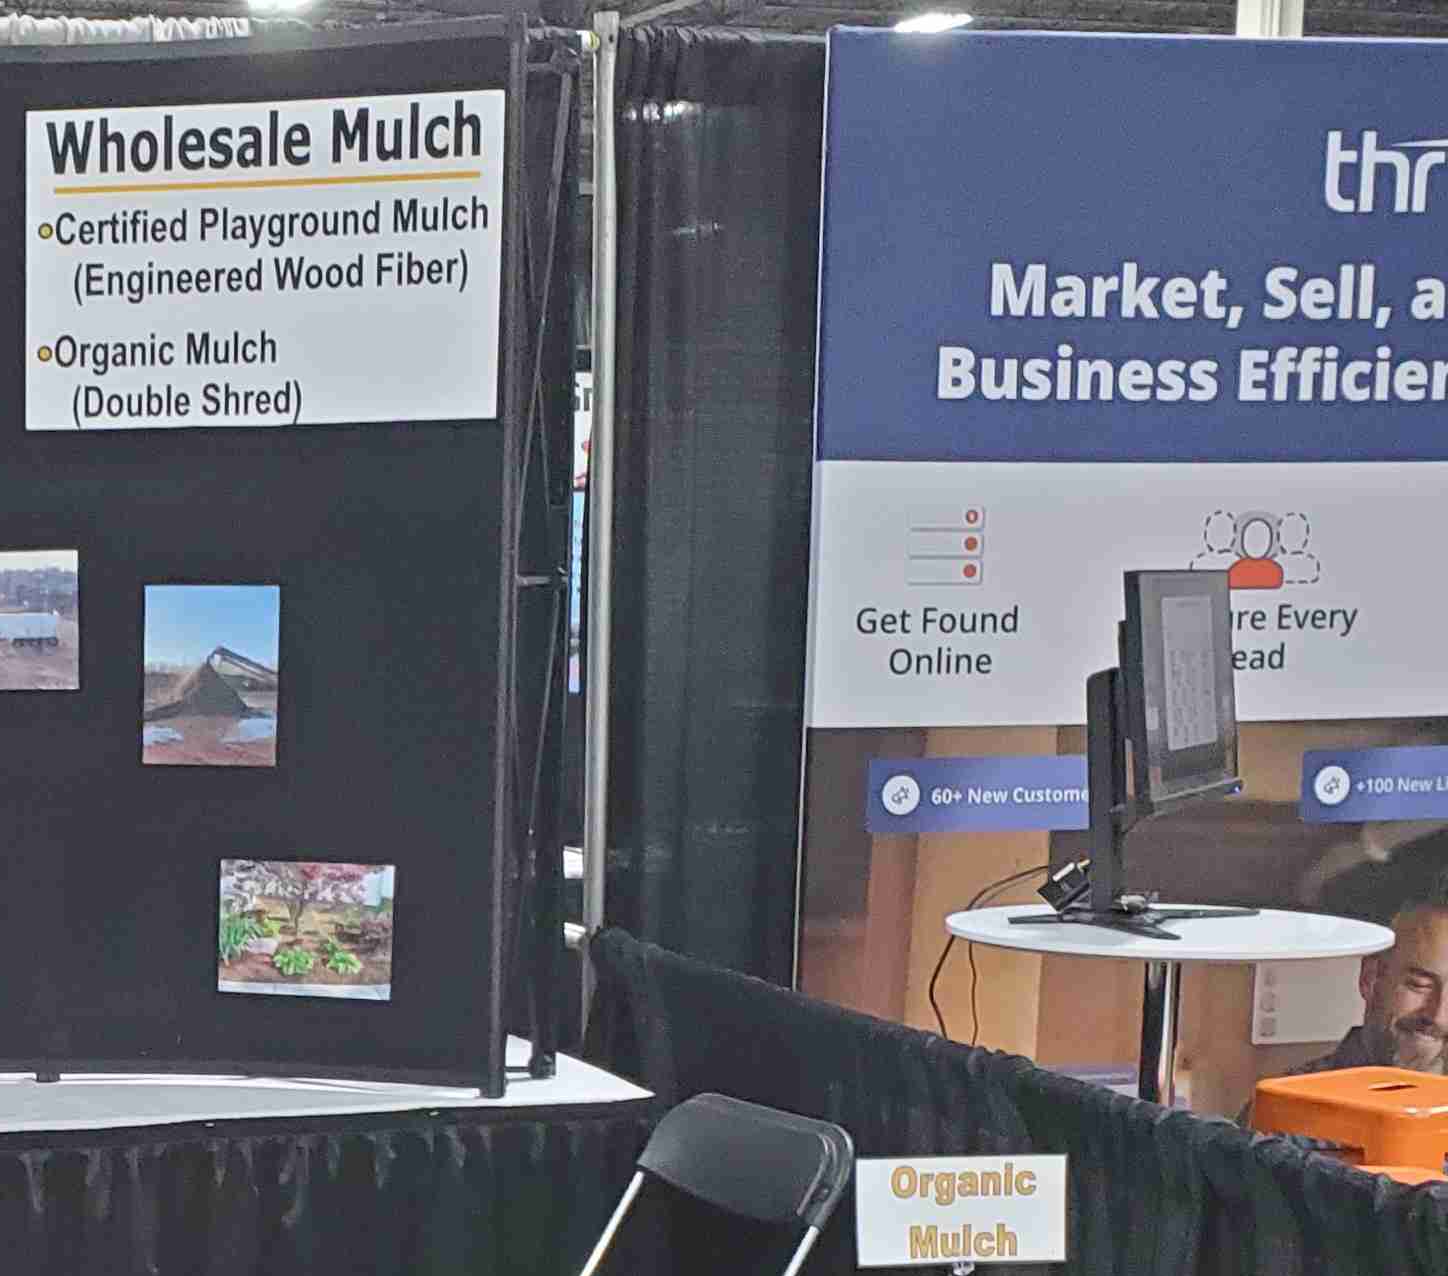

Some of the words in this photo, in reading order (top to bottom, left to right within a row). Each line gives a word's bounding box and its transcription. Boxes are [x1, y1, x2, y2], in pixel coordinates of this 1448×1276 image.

[46, 115, 311, 175] Wholesale
[331, 100, 482, 164] Mulch
[1325, 131, 1448, 212] thr
[56, 208, 187, 245] Certified
[200, 200, 380, 248] Playground
[393, 196, 488, 233] Mulch
[74, 258, 262, 306] (Engineered
[274, 254, 363, 290] Wood
[377, 249, 467, 292] Fiber)
[991, 262, 1243, 328] Market,
[1263, 264, 1391, 328] Sell,
[55, 333, 174, 376] Organic
[187, 330, 276, 365] Mulch
[938, 344, 1218, 401] Business
[72, 384, 191, 430] (Double
[202, 380, 303, 424] Shred)
[857, 608, 911, 634] Get
[923, 605, 1018, 634] Found
[1229, 609, 1267, 631] re
[1278, 604, 1358, 637] Every
[889, 647, 992, 675] Online
[1232, 642, 1285, 670] ead
[932, 788, 962, 805] 60+
[968, 787, 1008, 804] New
[1397, 776, 1433, 792] New
[1436, 776, 1448, 791] L
[890, 1163, 1037, 1206] Organic
[909, 1223, 1018, 1259] Mulch
